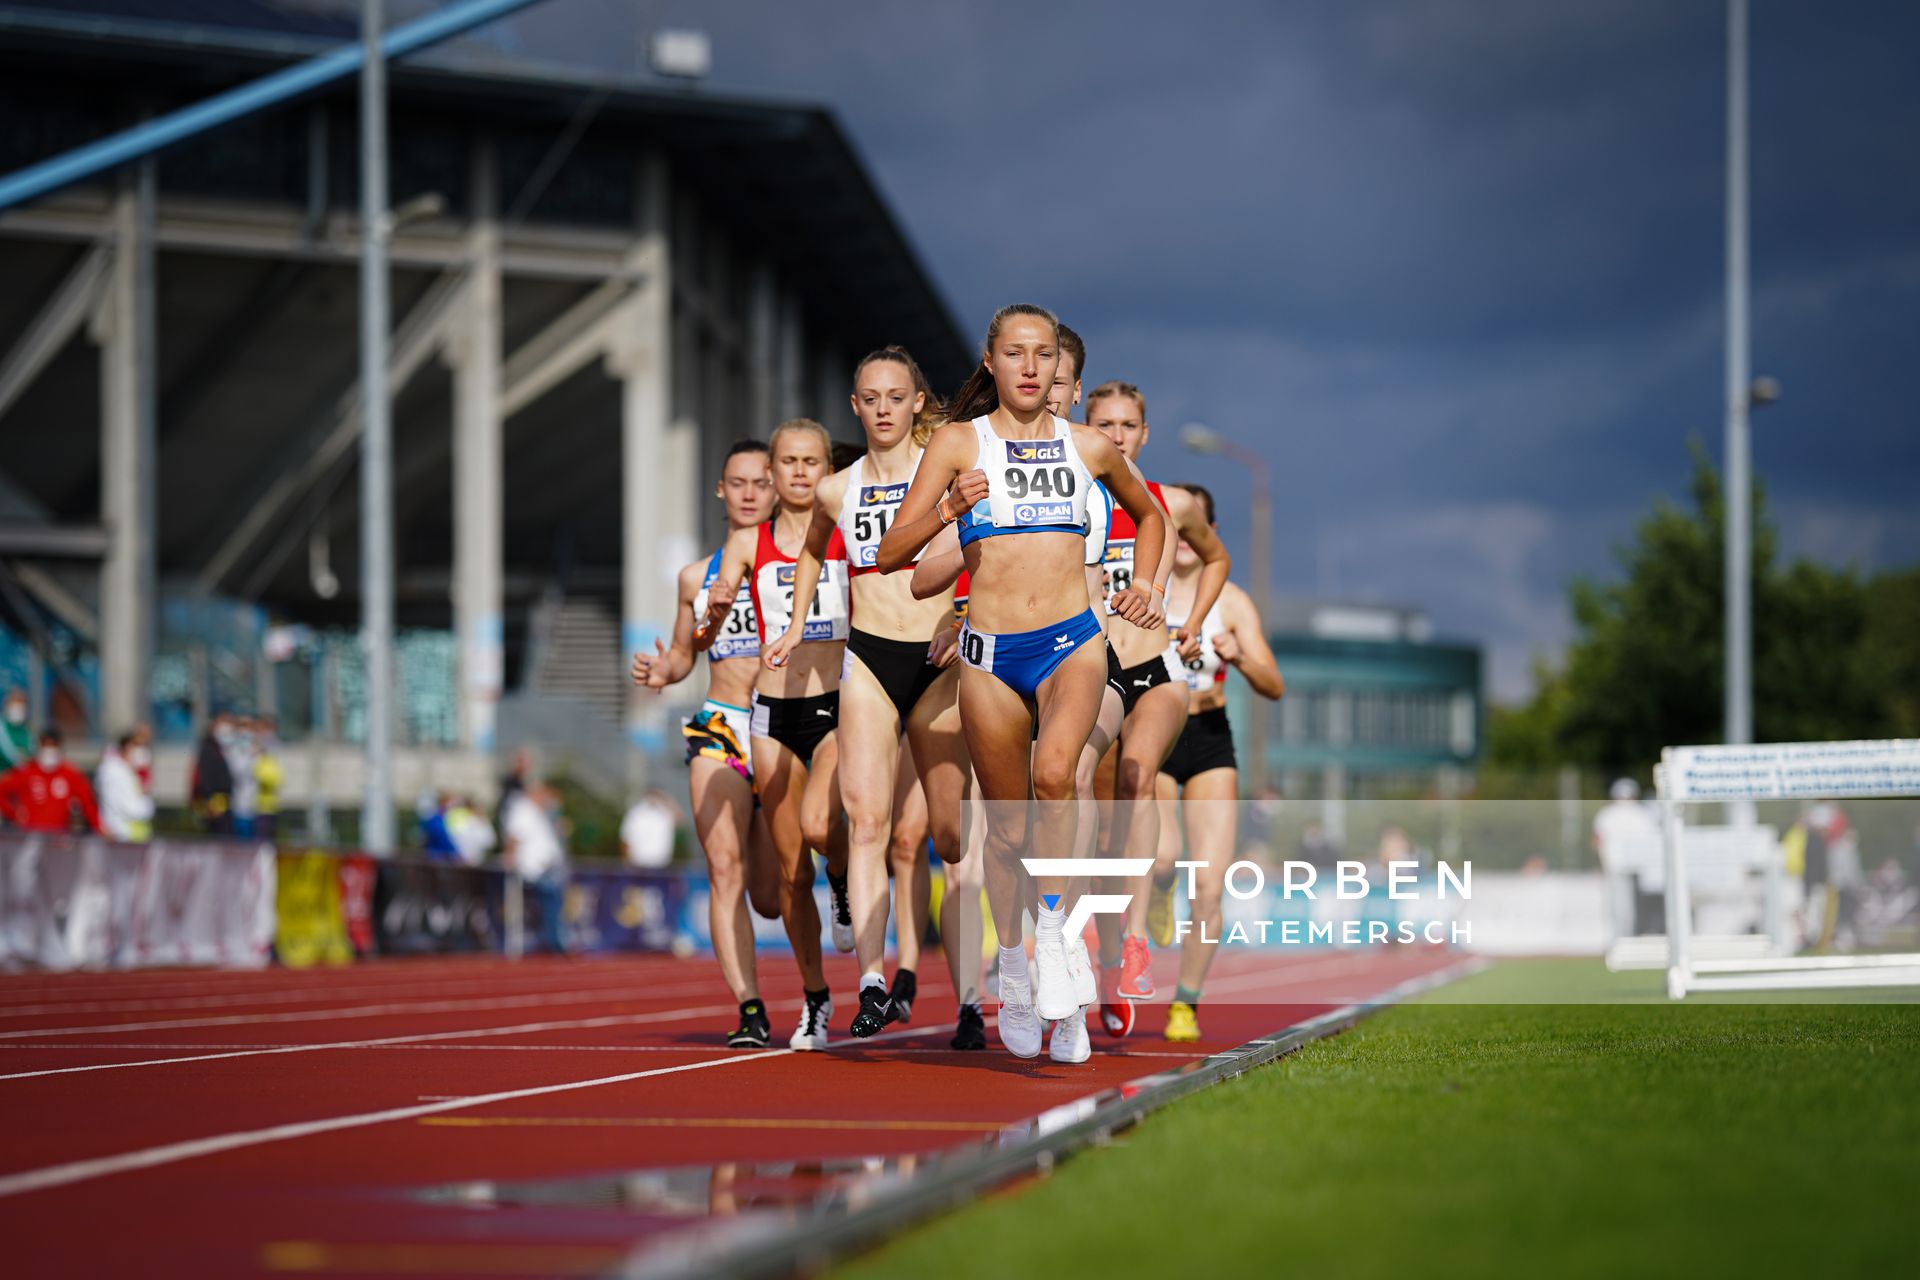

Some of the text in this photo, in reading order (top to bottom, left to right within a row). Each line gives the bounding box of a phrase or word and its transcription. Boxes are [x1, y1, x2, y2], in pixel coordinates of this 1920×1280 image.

[1037, 446, 1061, 460] GLS
[1004, 466, 1076, 499] 940
[885, 488, 906, 502] GLS
[1038, 505, 1072, 515] PLAN
[855, 509, 899, 542] 51
